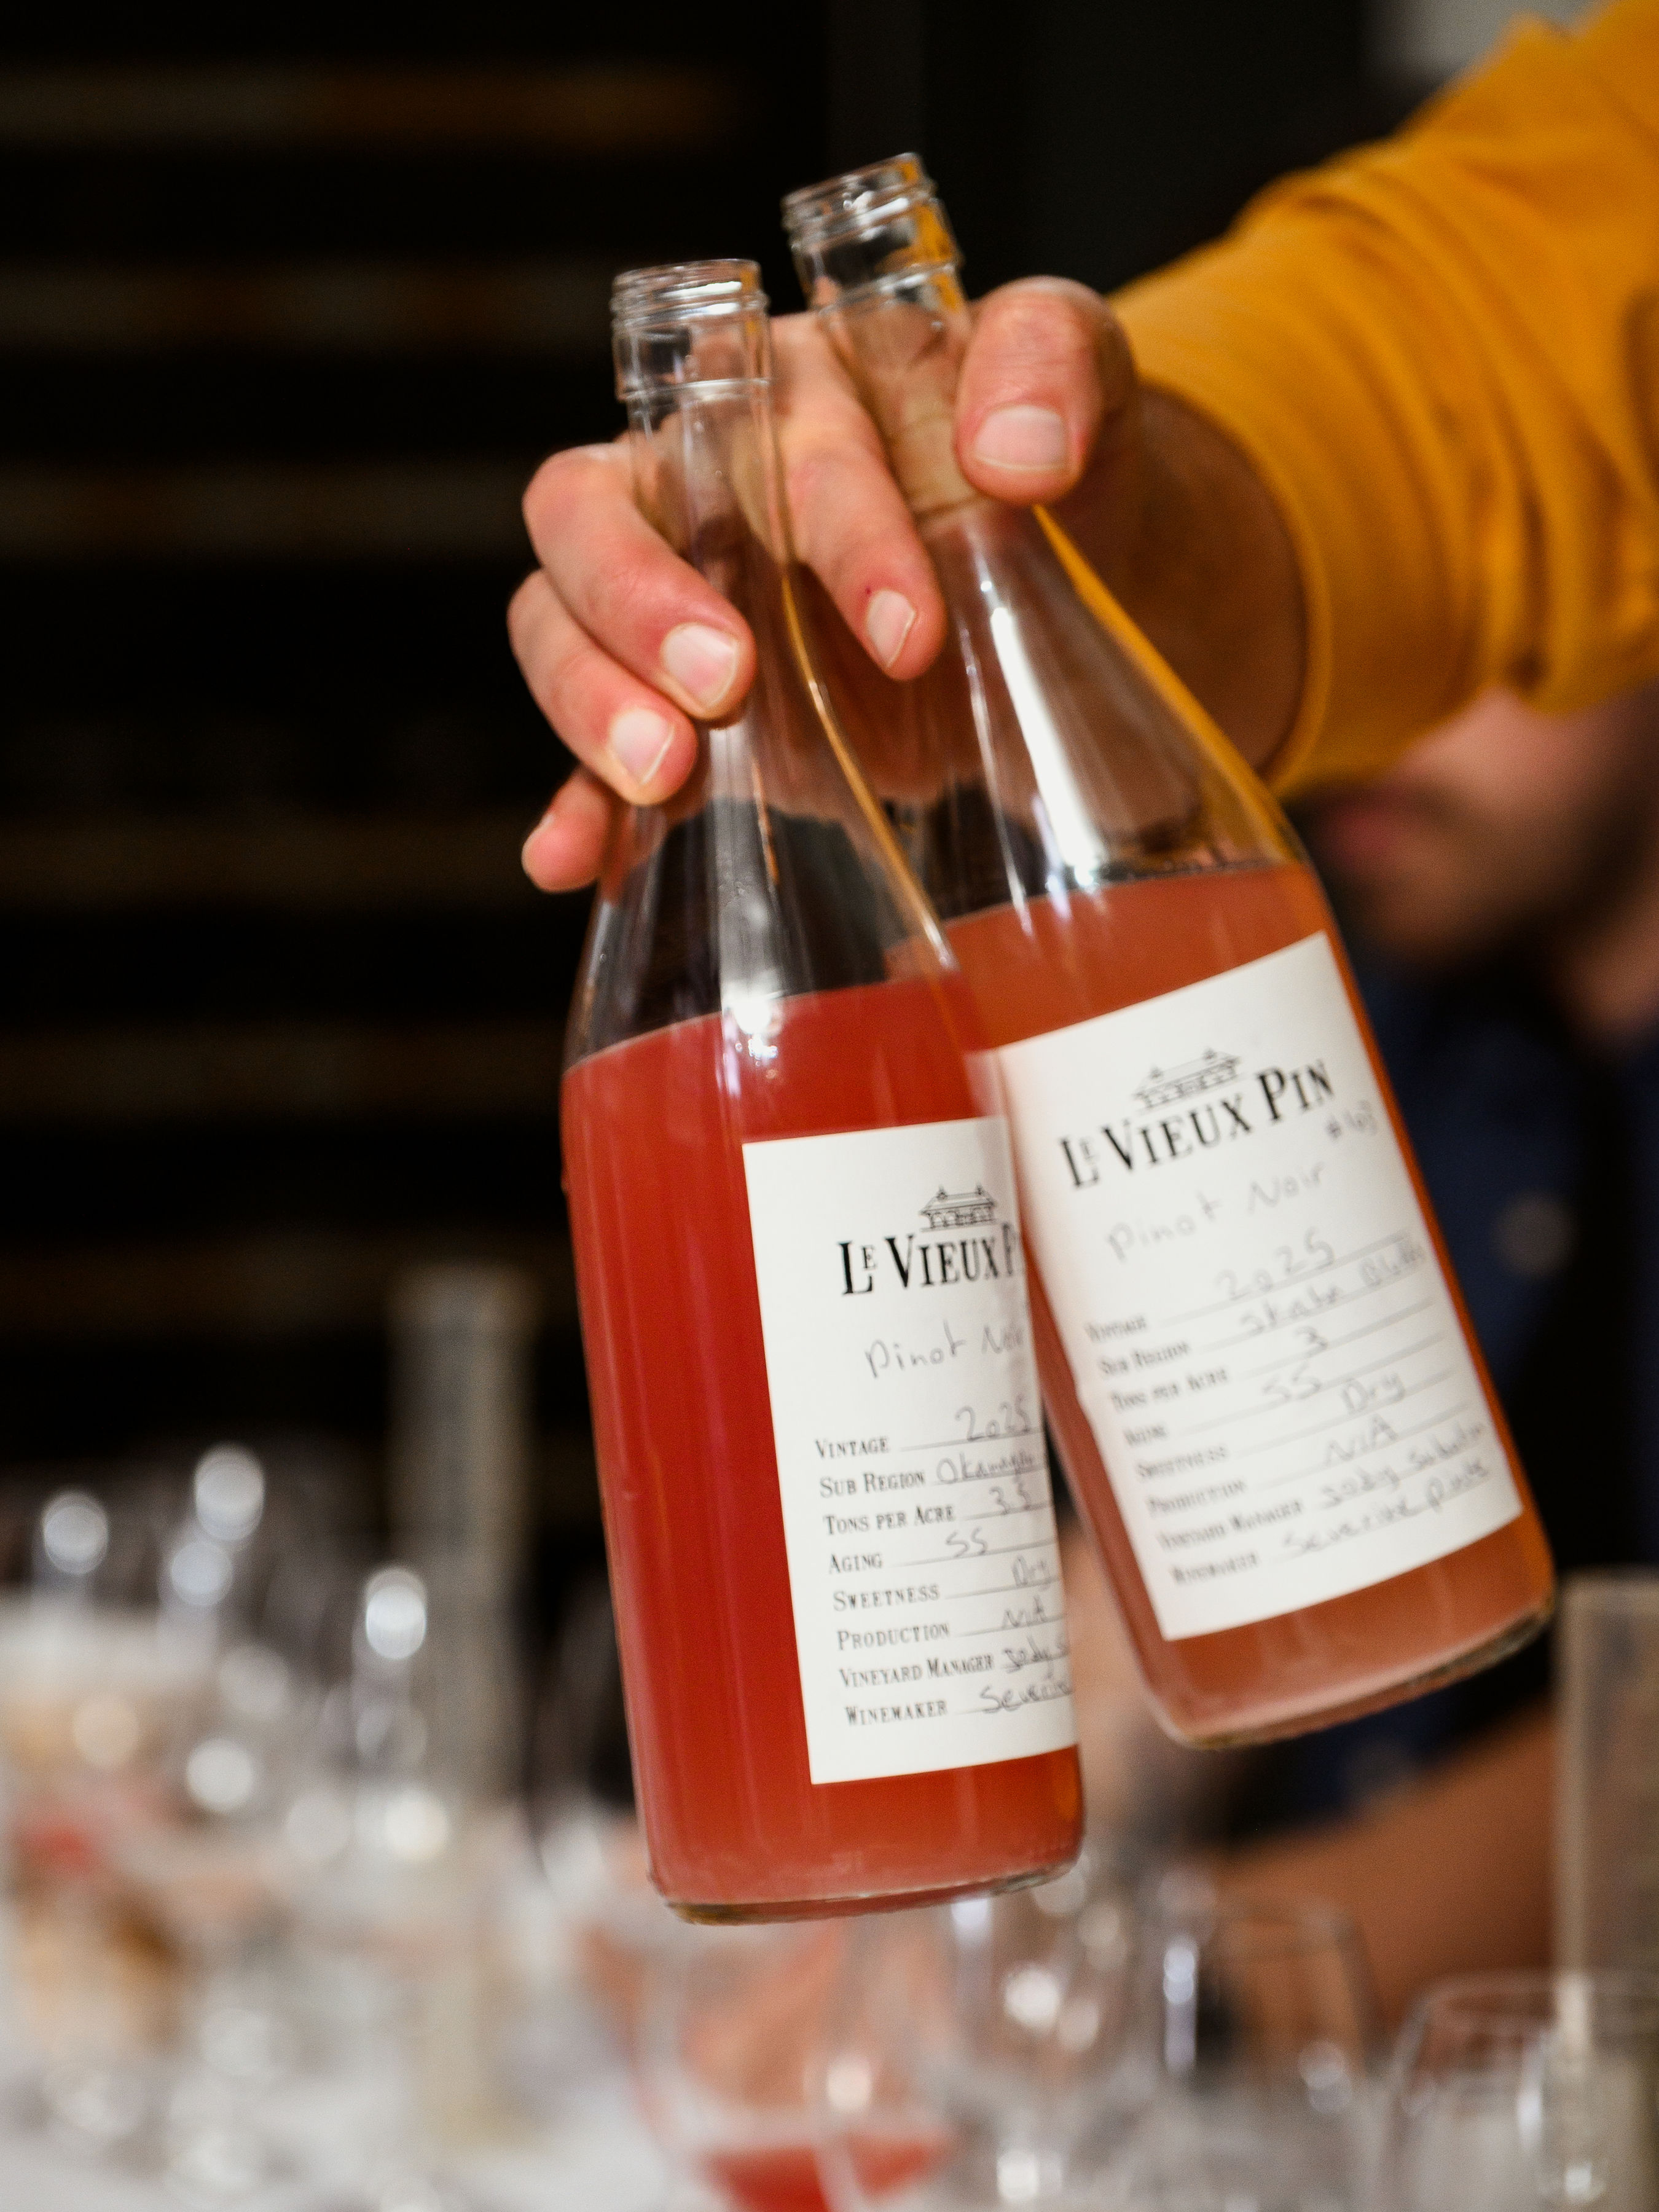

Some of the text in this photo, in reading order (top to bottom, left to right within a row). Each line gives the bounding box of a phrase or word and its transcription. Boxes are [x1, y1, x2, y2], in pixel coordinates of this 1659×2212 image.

[1255, 1059, 1336, 1124] PIN
[884, 1233, 1000, 1289] VIEUX
[815, 1437, 888, 1459] VINTAGE
[819, 1475, 857, 1498] SUB
[863, 1470, 925, 1493] REGION
[823, 1514, 869, 1536] TONS
[914, 1505, 957, 1525] ACRE
[828, 1553, 883, 1574] AGING
[833, 1584, 940, 1611] SWEETNESS
[837, 1623, 950, 1651] PRODUCTION
[839, 1663, 923, 1688] VINEYARD
[927, 1653, 994, 1677] MANAGER
[844, 1700, 948, 1726] WINEMAKER
